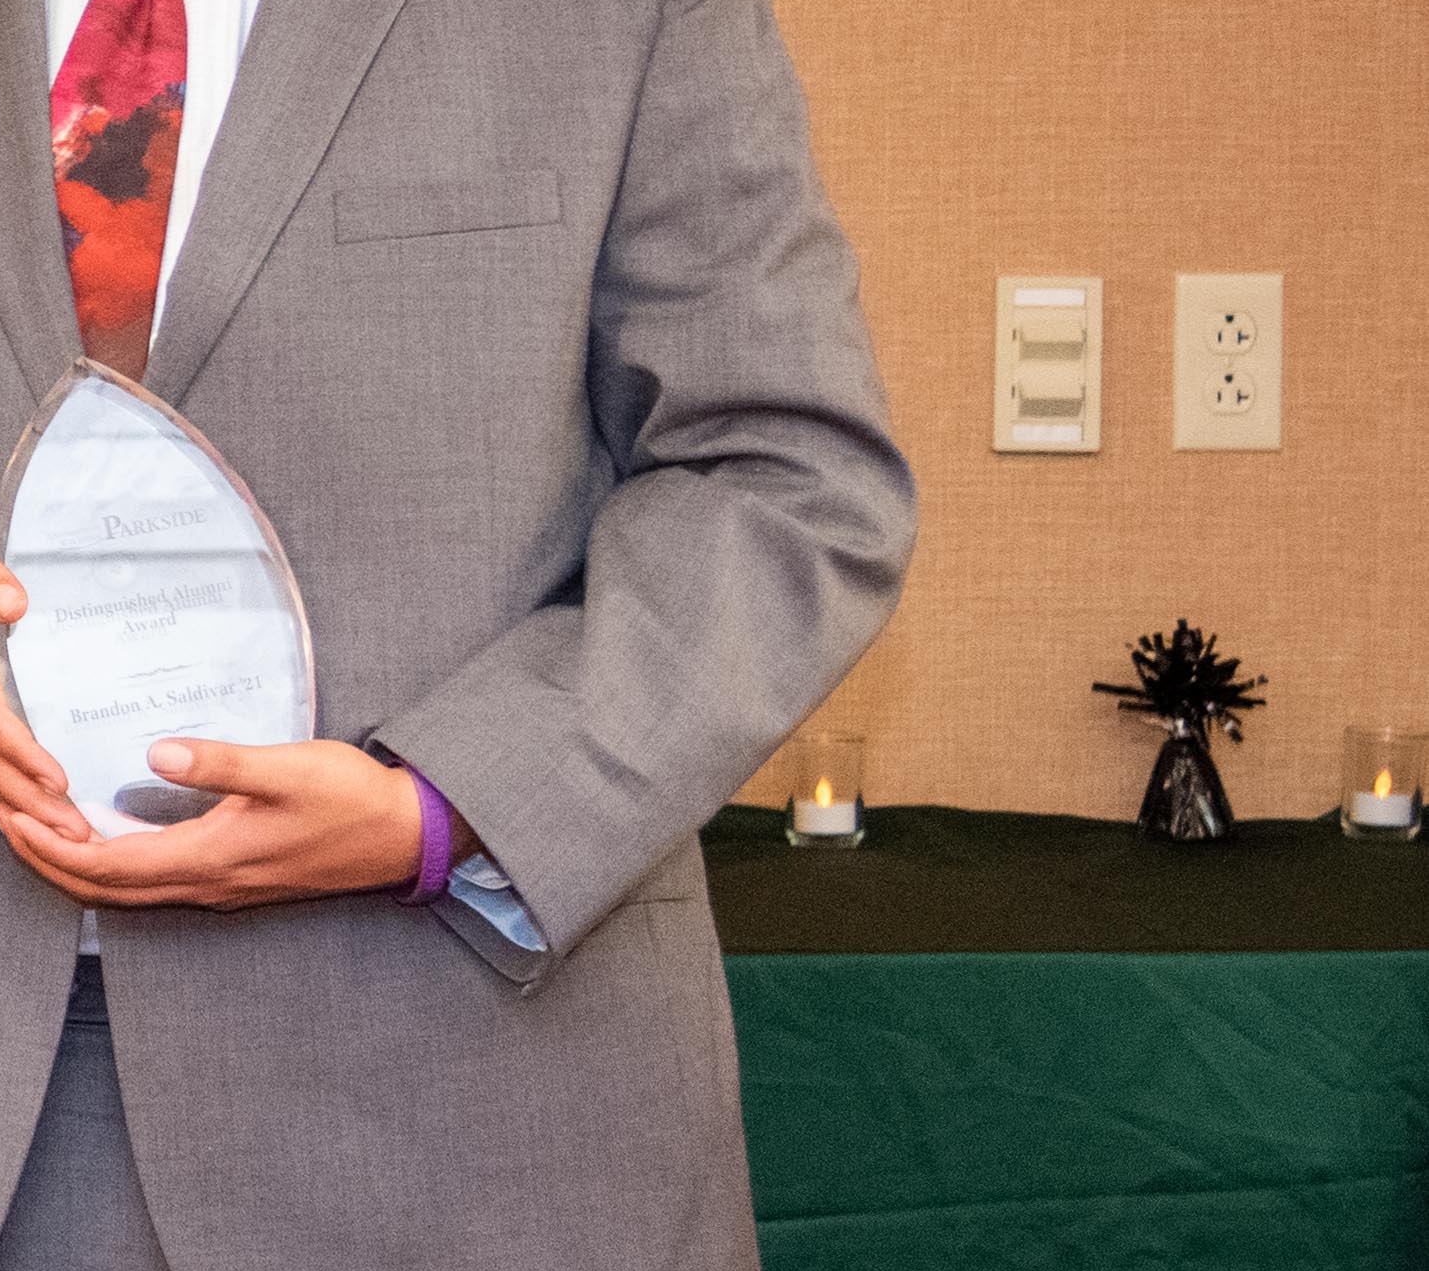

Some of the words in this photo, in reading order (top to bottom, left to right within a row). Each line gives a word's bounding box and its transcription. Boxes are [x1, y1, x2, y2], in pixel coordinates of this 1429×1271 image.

[102, 508, 207, 540] PARKSIDE
[55, 588, 166, 623] Distinguished
[172, 577, 233, 601] Alumni
[123, 611, 177, 633] Award
[70, 700, 143, 724] Brandon
[165, 681, 237, 706] Saldivar
